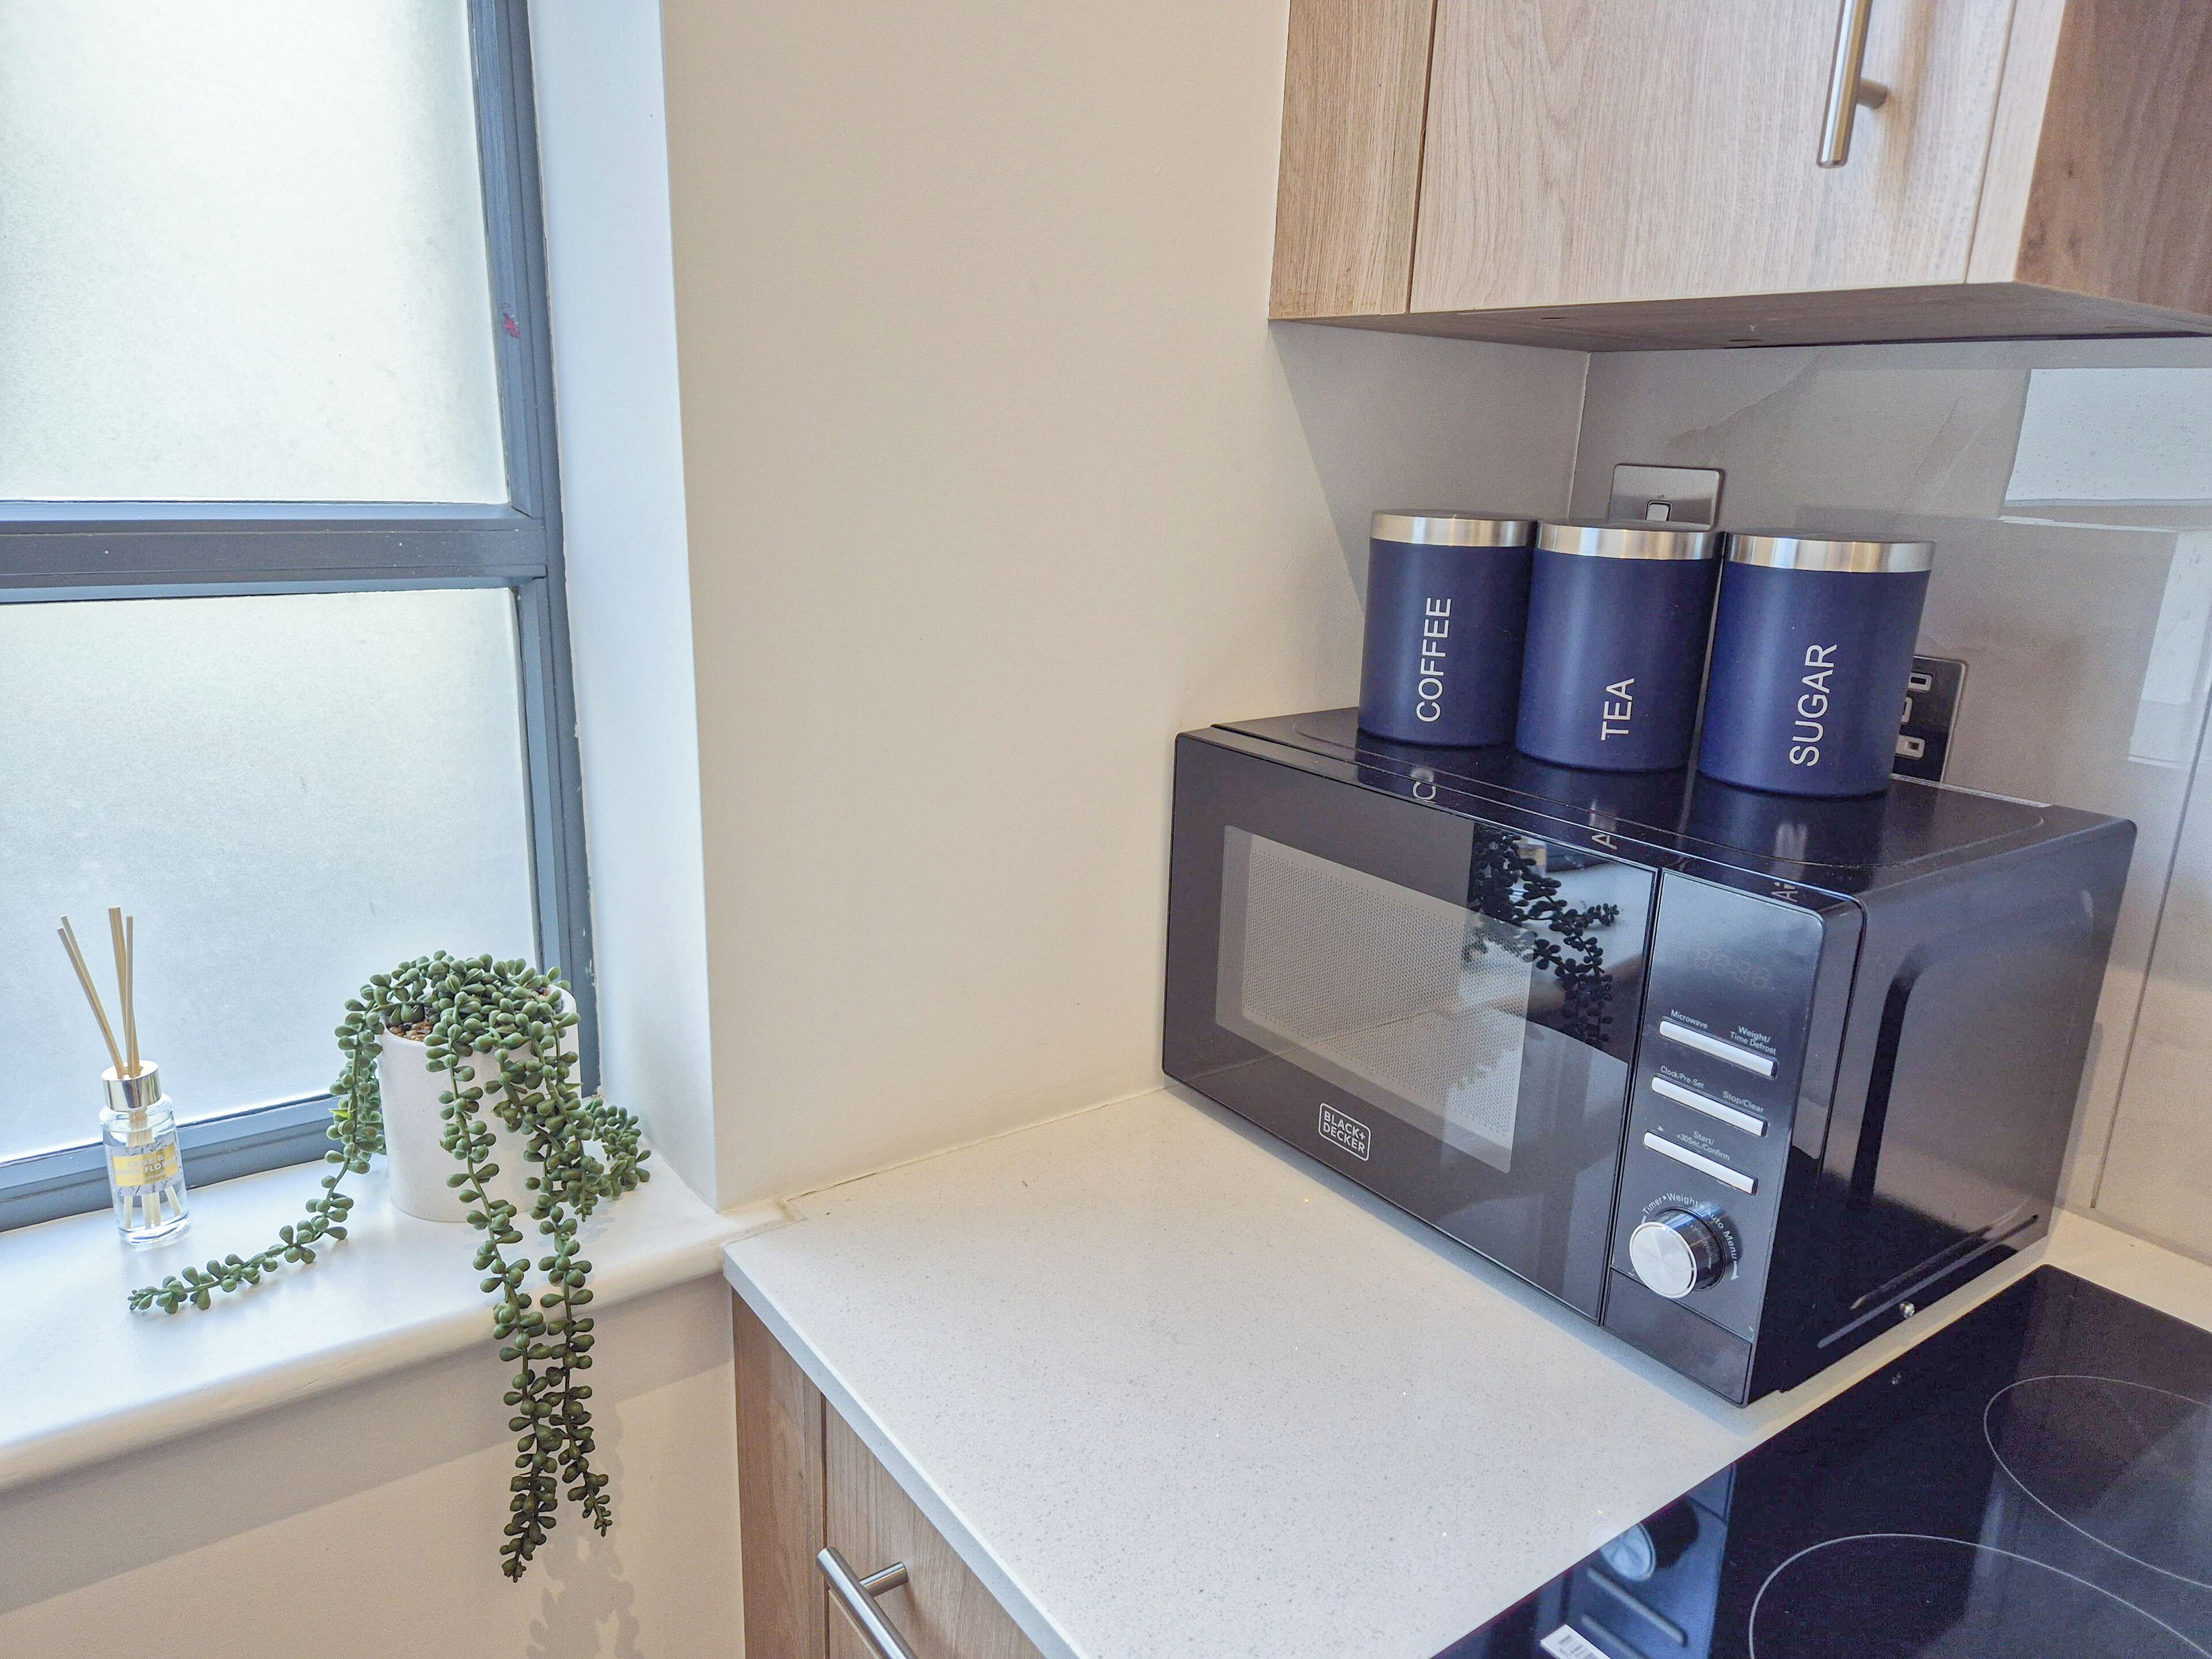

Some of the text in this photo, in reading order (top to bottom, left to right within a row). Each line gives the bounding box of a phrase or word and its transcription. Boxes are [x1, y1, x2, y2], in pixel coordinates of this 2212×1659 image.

[1416, 597, 1452, 722] COFFEE
[1601, 677, 1635, 741] TEA
[1789, 642, 1837, 766] SUGAR
[1671, 1009, 1708, 1029] Microwave
[1730, 1031, 1777, 1055] Time Defrost
[1738, 1026, 1771, 1043] Weight/
[1660, 1066, 1705, 1089] Clock/Pre-Set
[1722, 1090, 1764, 1113] Stop/Clear
[1323, 1121, 1365, 1153] DECKER
[1324, 1110, 1366, 1139] BLACK+
[1693, 1131, 1715, 1145] Start/
[1642, 1196, 1662, 1215] Timer
[1666, 1193, 1699, 1207] Weight
[1705, 1208, 1724, 1229] Auto
[1723, 1230, 1738, 1259] Menu
